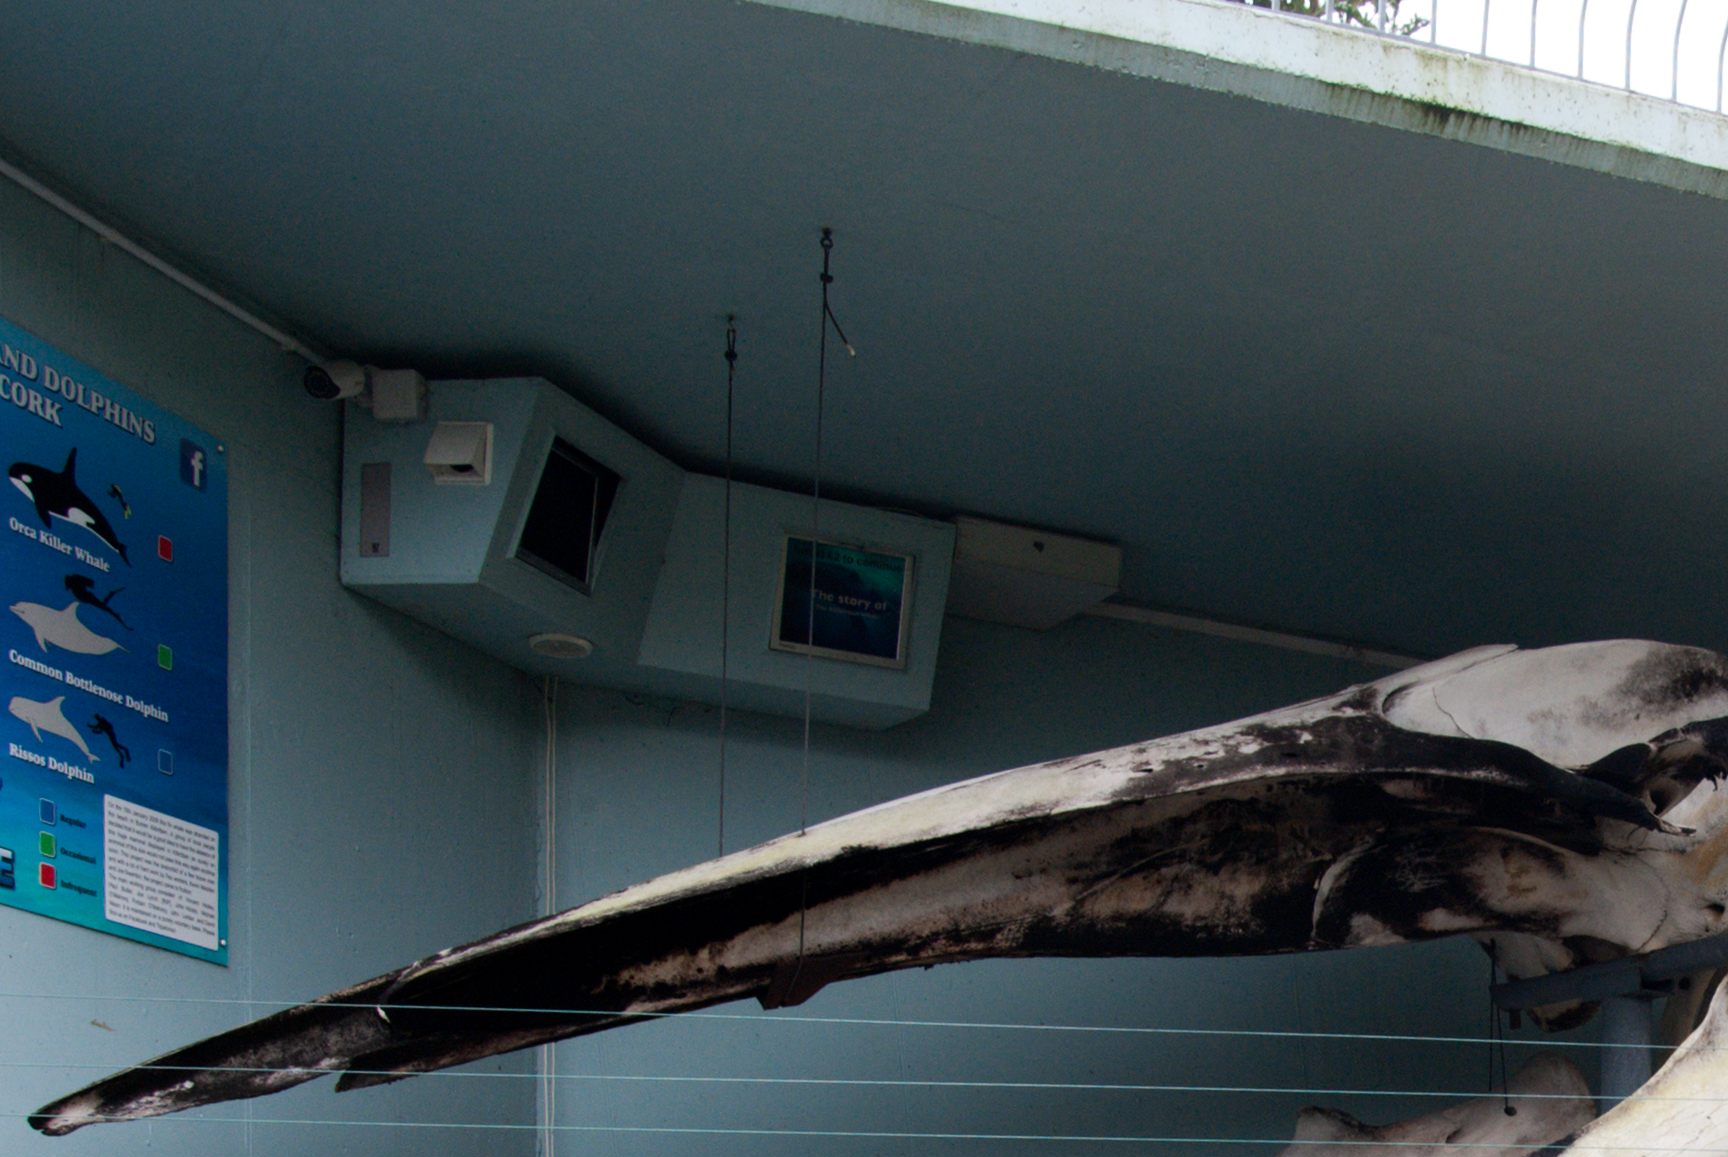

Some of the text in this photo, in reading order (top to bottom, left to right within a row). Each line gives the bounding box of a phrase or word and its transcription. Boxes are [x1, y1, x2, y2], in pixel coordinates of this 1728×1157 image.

[0, 344, 155, 443] ND DOLPHINS
[9, 517, 110, 572] Orca Killer Whale
[838, 595, 871, 610] story
[875, 601, 886, 611] of
[9, 649, 169, 722] Common Bottlenose Dolphin
[9, 743, 94, 784] Rissos Dolphin
